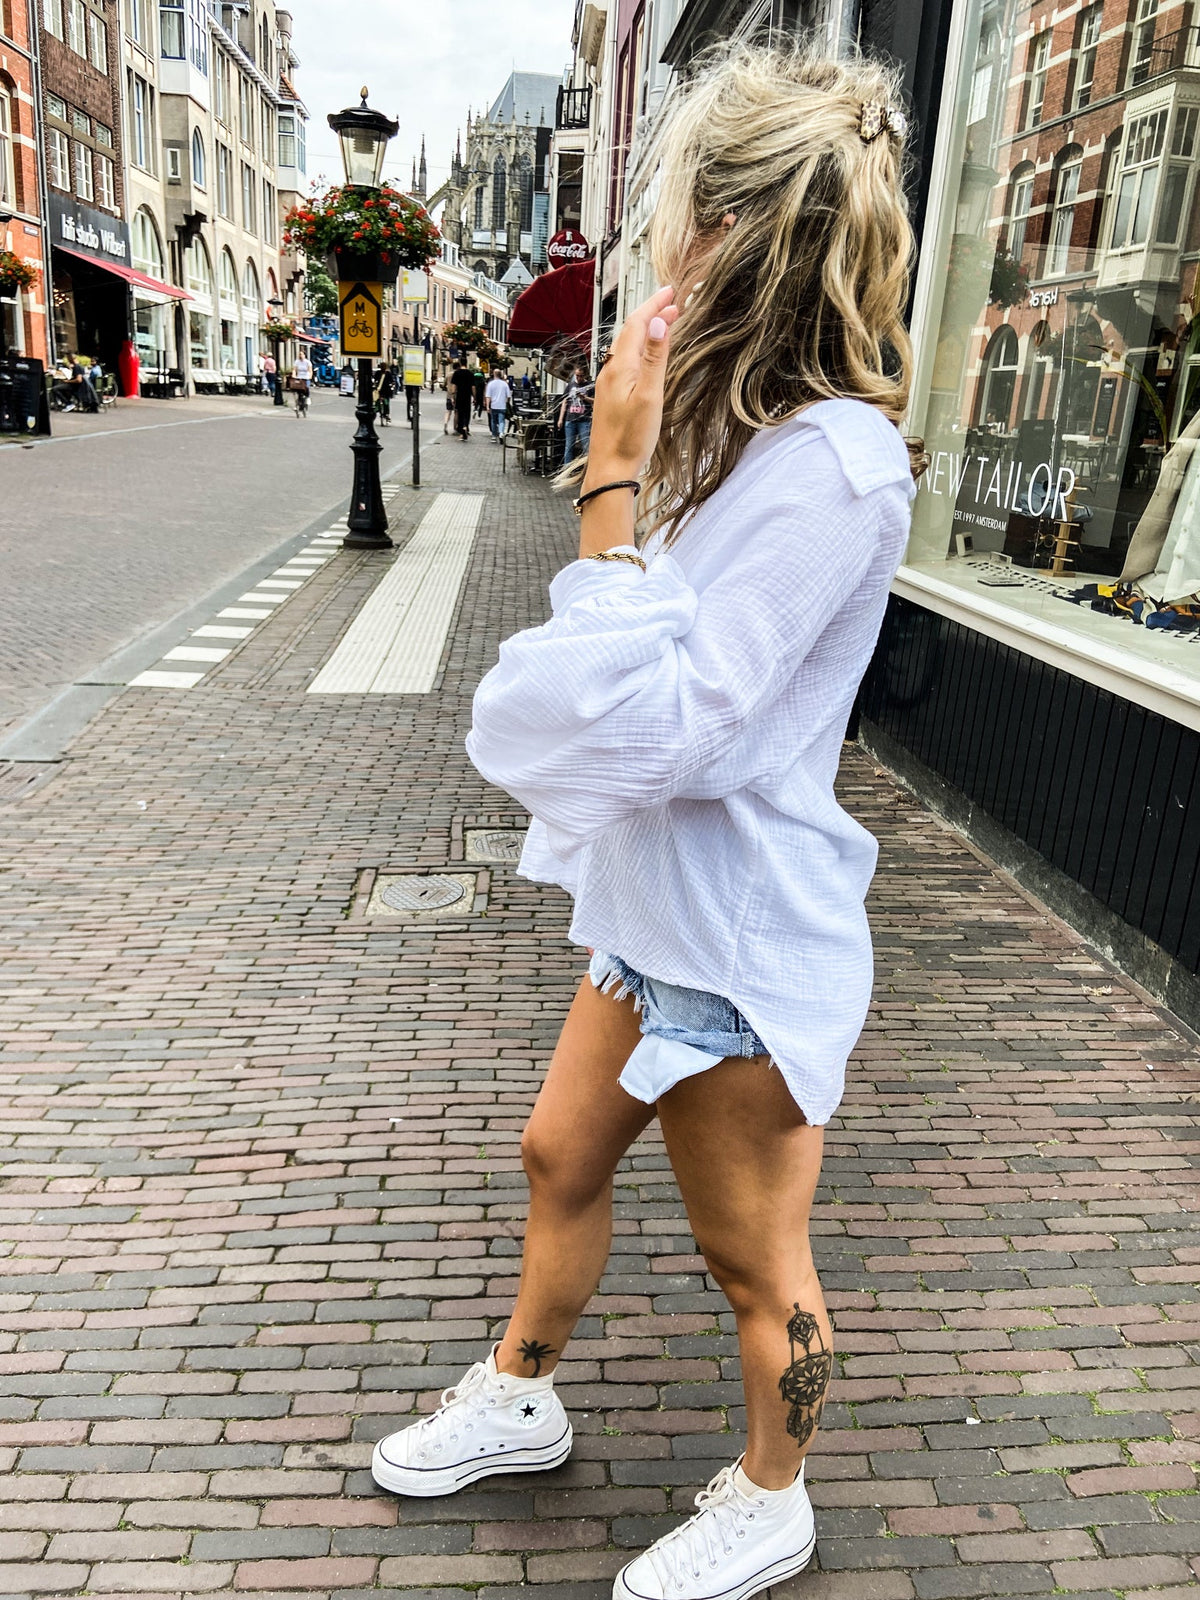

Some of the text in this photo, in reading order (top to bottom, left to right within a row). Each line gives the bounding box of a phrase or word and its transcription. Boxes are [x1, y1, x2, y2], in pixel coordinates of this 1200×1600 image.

[75, 223, 99, 250] studio
[100, 229, 126, 258] Wilbert
[549, 241, 587, 258] Coca-Cola
[355, 301, 365, 313] M
[917, 450, 1075, 522] NEW TAILOR
[964, 512, 976, 523] 1997
[975, 517, 1007, 532] AMSTERDAM
